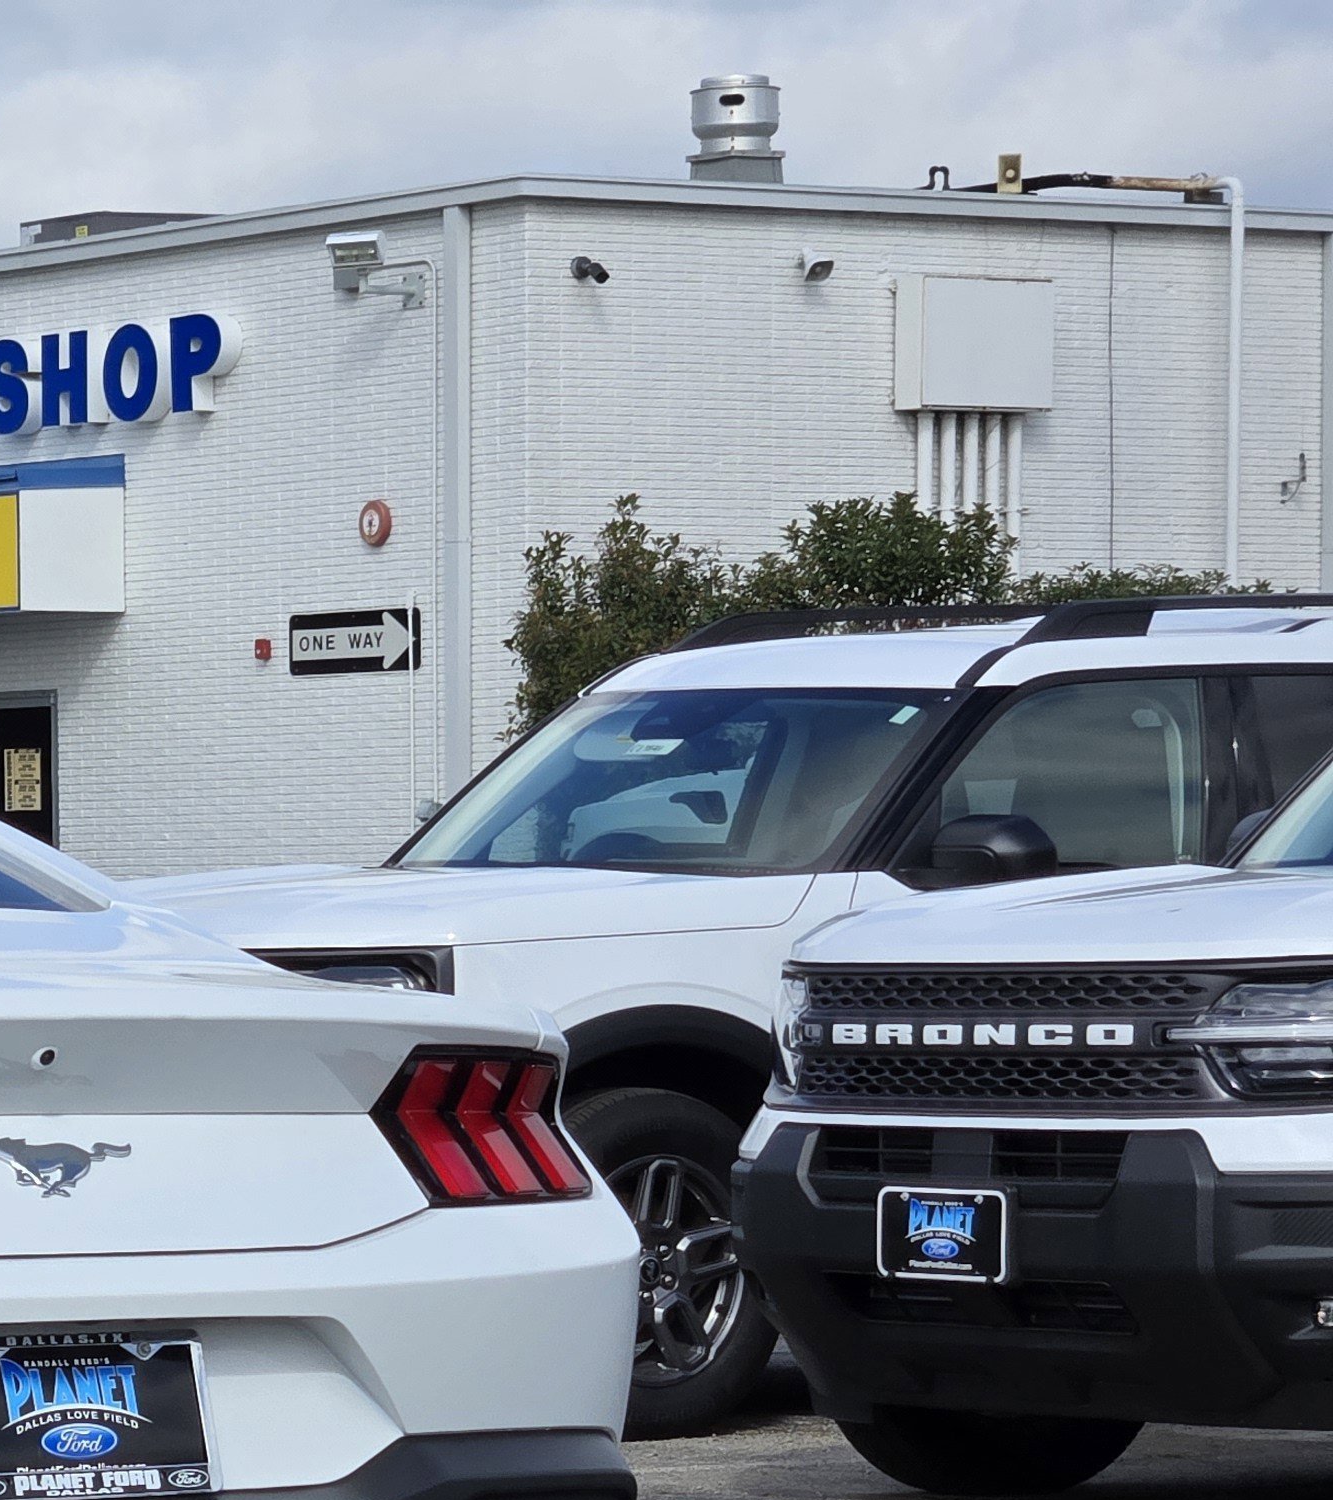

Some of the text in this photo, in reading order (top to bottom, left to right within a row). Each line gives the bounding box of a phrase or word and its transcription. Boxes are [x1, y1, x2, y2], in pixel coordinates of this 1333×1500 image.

[299, 631, 384, 652] ONE WAY
[832, 1024, 1134, 1046] BRONCO
[908, 1198, 975, 1237] PLANET
[23, 1359, 70, 1368] RANDALL
[15, 1410, 140, 1435] DALLAS LOVE FIELD
[56, 1429, 103, 1453] Ford
[13, 1469, 162, 1497] PLANET FORD
[46, 1486, 125, 1497] DALLAS
